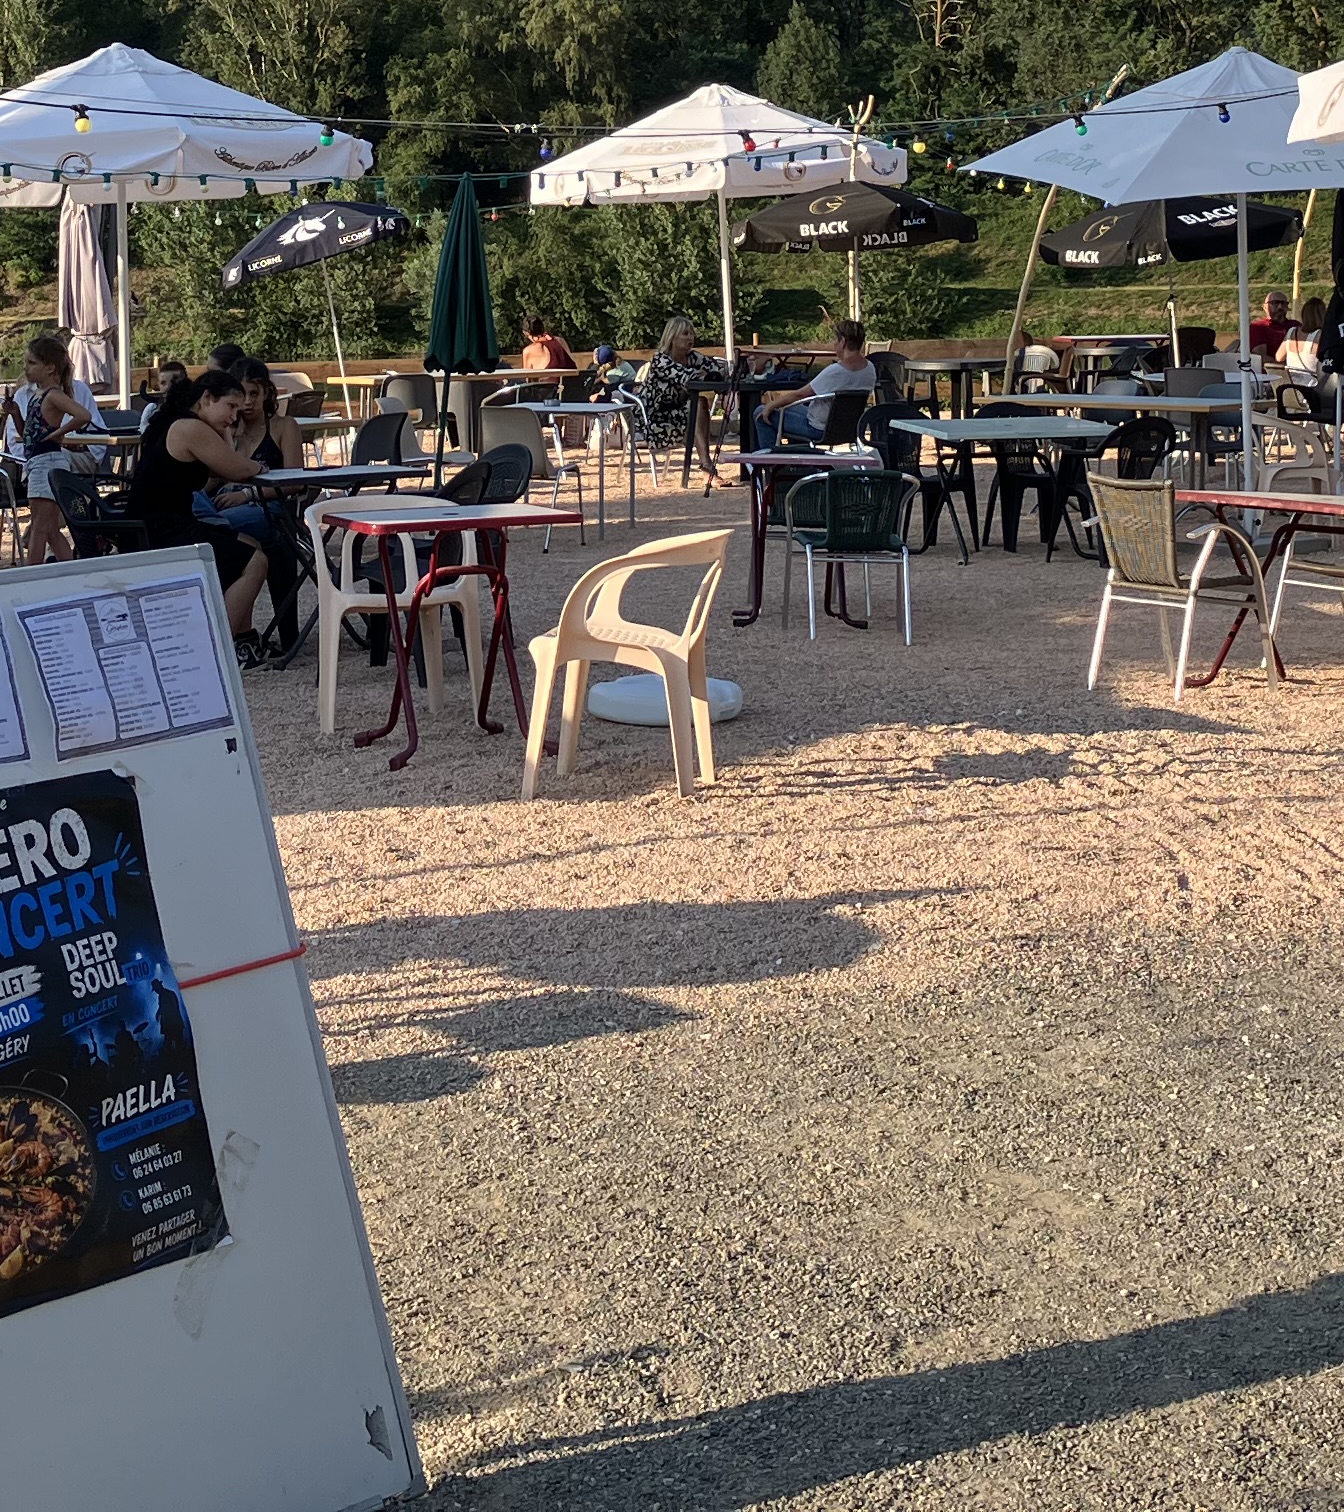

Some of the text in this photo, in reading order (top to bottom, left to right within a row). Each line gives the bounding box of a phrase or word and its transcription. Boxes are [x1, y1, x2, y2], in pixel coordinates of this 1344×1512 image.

[1245, 158, 1332, 177] CARTE
[799, 220, 849, 237] BLACK
[1065, 249, 1100, 264] BLACK
[1137, 253, 1162, 266] BLACK
[59, 930, 119, 973] DEEP
[69, 959, 151, 1000] SOUL TRIO
[61, 994, 120, 1028] EN CONCERT
[100, 1073, 177, 1128] PAELLA
[128, 1142, 161, 1164] MÉLANIE
[132, 1166, 144, 1179] 06
[144, 1162, 154, 1175] 24
[164, 1154, 174, 1167] 03
[174, 1150, 183, 1163] 27
[137, 1183, 162, 1200] KARIM
[141, 1202, 153, 1215] 06
[183, 1184, 192, 1197] 73
[131, 1208, 197, 1248] VENEZ PARTAGER
[132, 1249, 146, 1263] UN
[146, 1241, 163, 1256] BON
[165, 1223, 197, 1249] MOMENT
